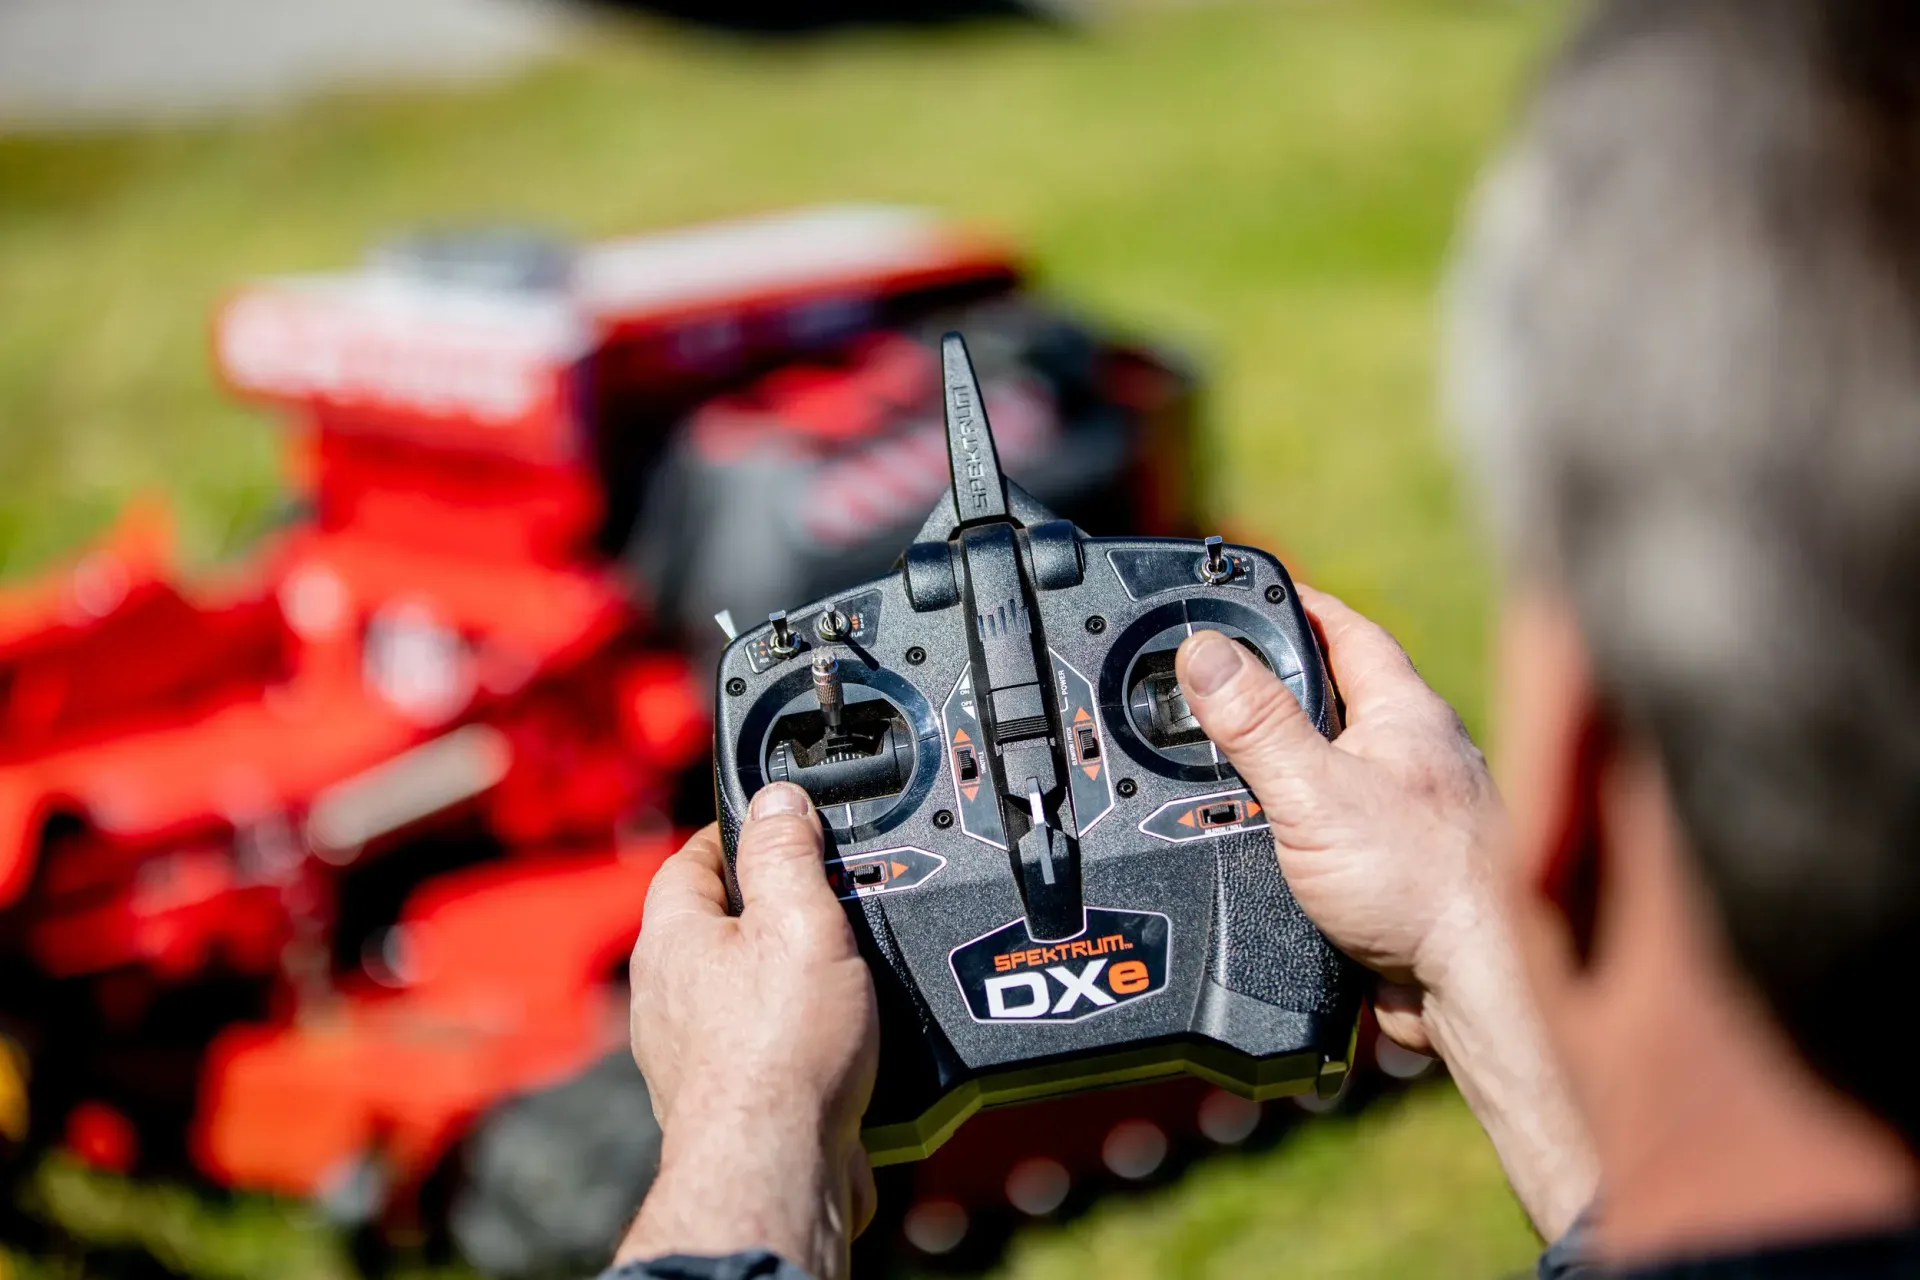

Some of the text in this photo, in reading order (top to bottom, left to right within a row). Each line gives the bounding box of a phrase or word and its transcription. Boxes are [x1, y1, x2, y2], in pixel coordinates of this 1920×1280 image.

[953, 384, 988, 510] SPEKTRUM
[1058, 670, 1069, 696] POWER
[993, 934, 1124, 972] SPEKTRUM
[984, 958, 1150, 1018] DXe
